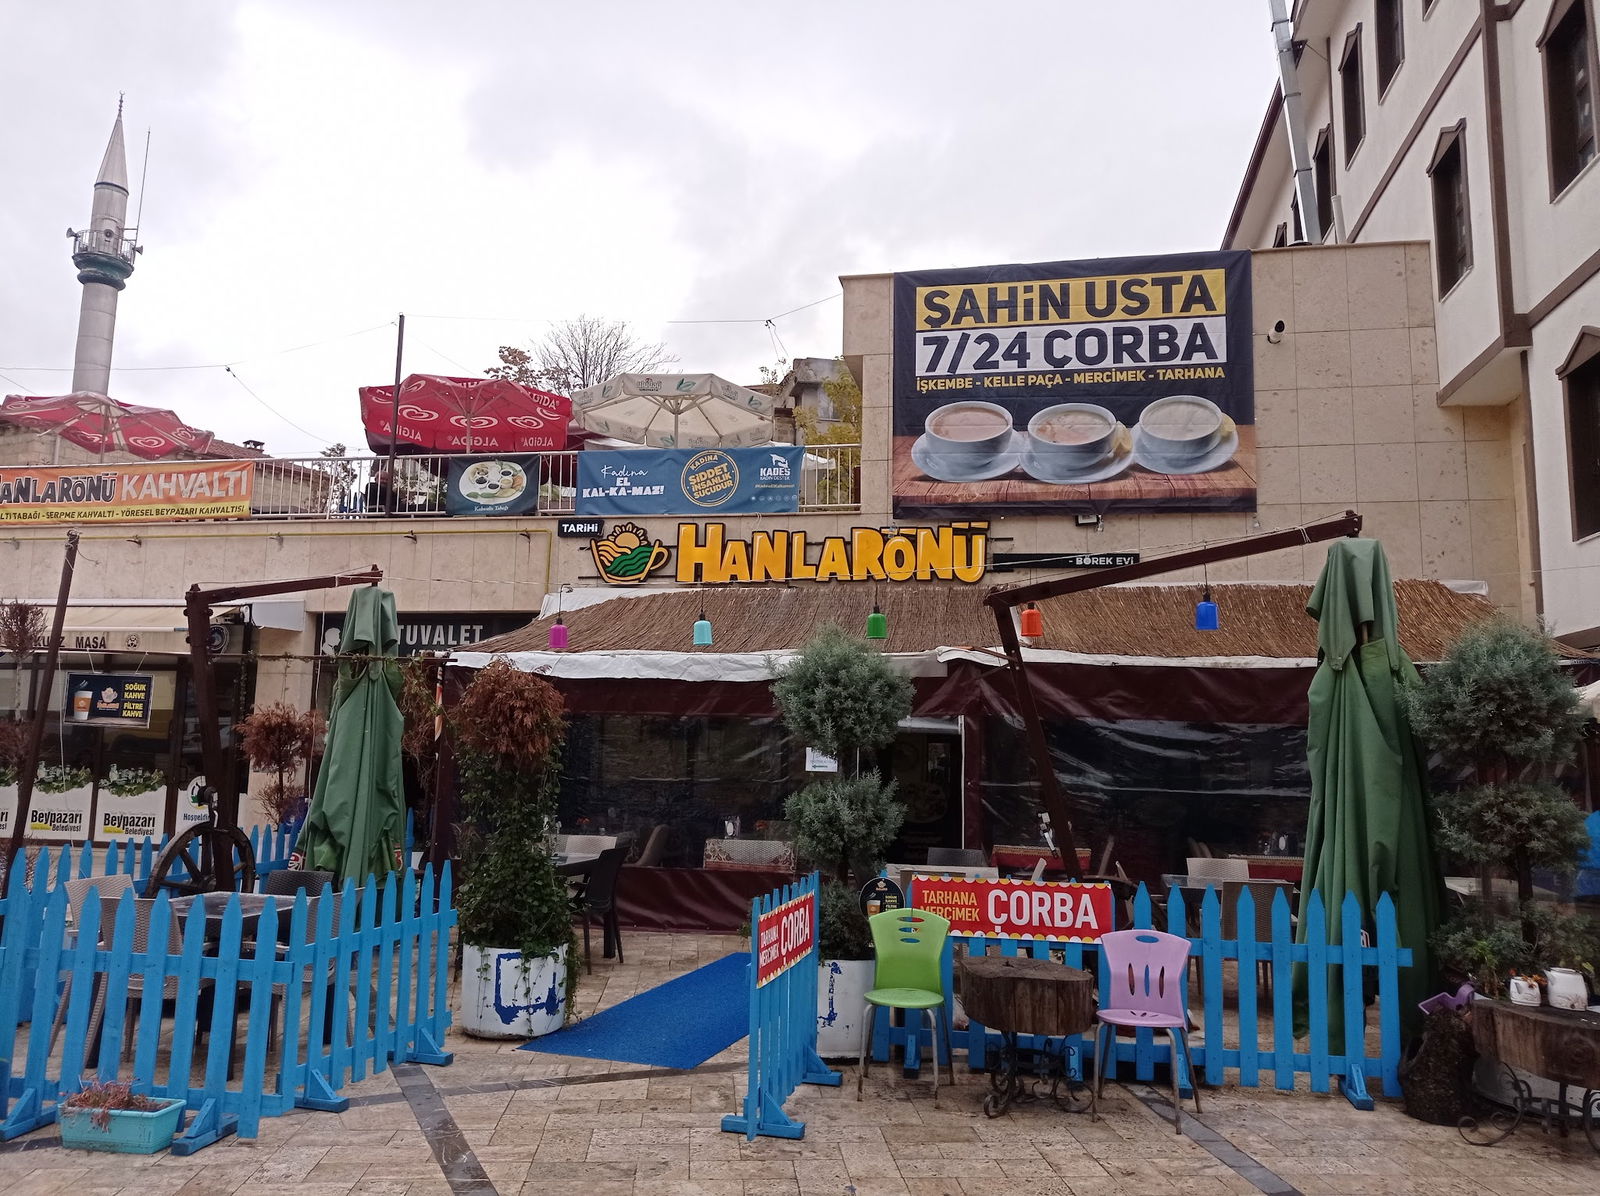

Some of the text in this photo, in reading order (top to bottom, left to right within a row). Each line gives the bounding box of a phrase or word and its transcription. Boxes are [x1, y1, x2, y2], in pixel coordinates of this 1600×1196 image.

[1084, 273, 1218, 318] USTA
[922, 322, 1219, 374] 7/24 ÇORBA
[916, 377, 973, 394] İŞKEMBE
[984, 376, 1025, 388] KELLE
[1028, 374, 1063, 388] PAÇA
[1073, 368, 1146, 384] MERCİMEK
[1157, 367, 1225, 380] TARHANA
[690, 455, 718, 470] KADINA
[760, 467, 790, 476] KADES
[0, 471, 248, 504] ANLARÖNÜ KAHVALTI
[616, 477, 630, 487] EL
[582, 486, 664, 498] KAL-KA-MAZ!
[13, 510, 40, 519] TABAĞI
[46, 511, 76, 519] SERPME
[77, 510, 114, 518] KAHVALTI
[121, 508, 154, 517] YÖRESEL
[155, 507, 197, 516] BEYPAZARI
[200, 505, 245, 515] KAHVALTISI
[676, 521, 990, 583] HANLARÖNÜ
[1076, 556, 1113, 565] BÖREK
[75, 636, 106, 649] MASA
[397, 624, 484, 646] TUVALET
[31, 810, 82, 826] Beypazarı
[104, 813, 155, 830] Beypazarı
[125, 828, 155, 836] Belediyesi
[922, 890, 977, 905] TARHANA
[987, 889, 1099, 933] ÇORBA
[781, 905, 810, 966] ÇORBA
